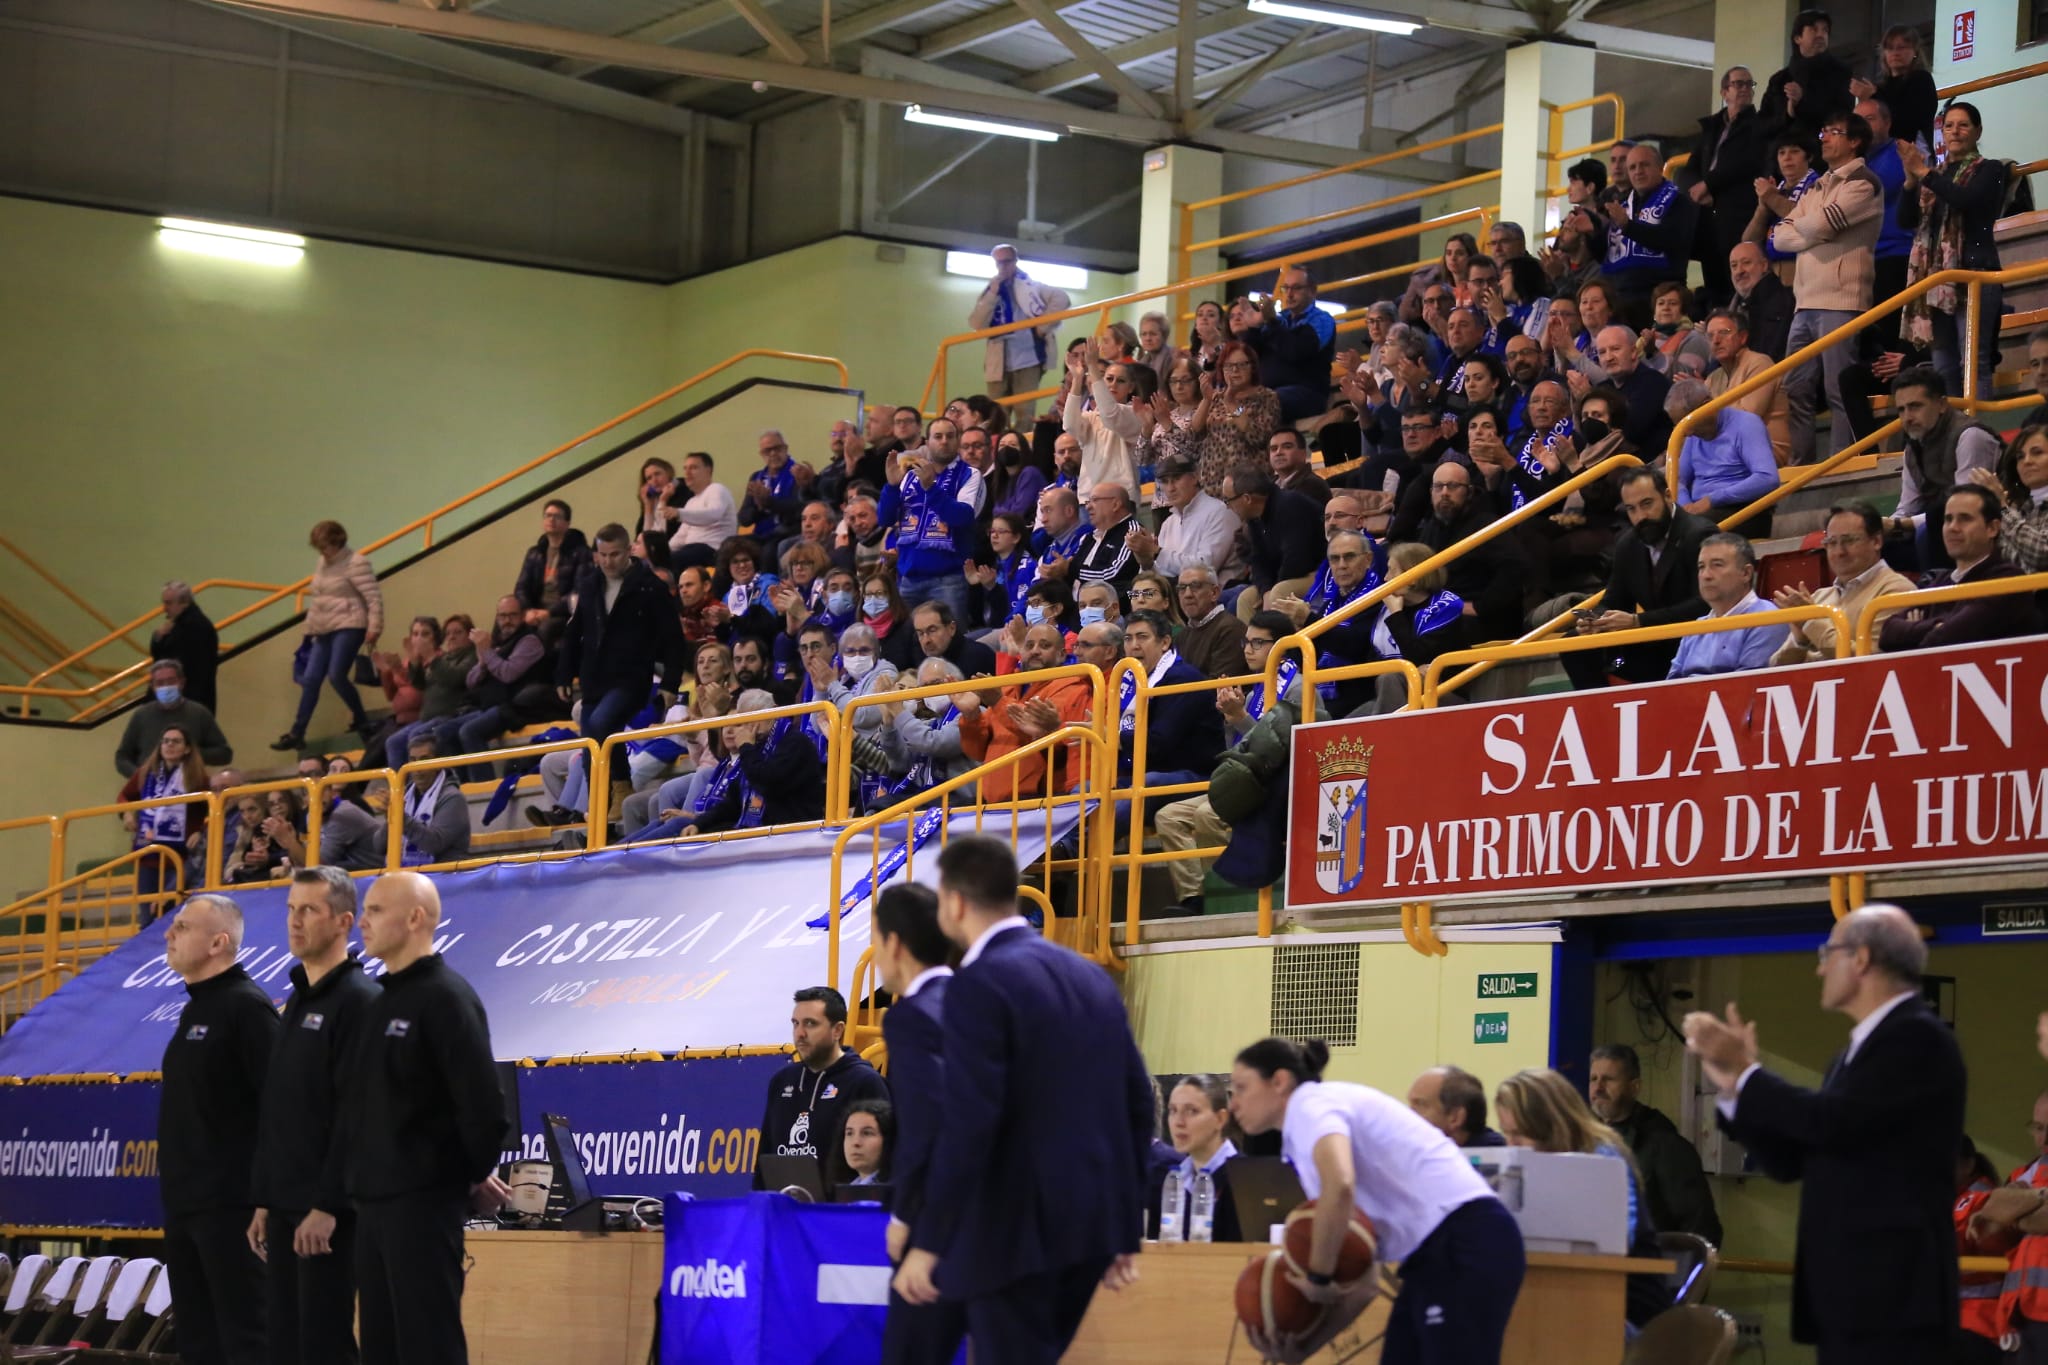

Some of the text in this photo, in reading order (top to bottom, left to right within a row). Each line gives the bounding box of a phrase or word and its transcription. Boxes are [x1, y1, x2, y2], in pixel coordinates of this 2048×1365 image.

[1481, 657, 2048, 796] SALAMAN
[1383, 767, 2048, 888] PATRIMONIO DE LA HUM
[1997, 908, 2046, 928] SALIDA
[496, 911, 724, 967] CASTILLA
[708, 904, 791, 963] Y
[530, 979, 599, 1005] NOS
[1482, 977, 1517, 995] SALIDA
[1485, 1023, 1500, 1034] DEA
